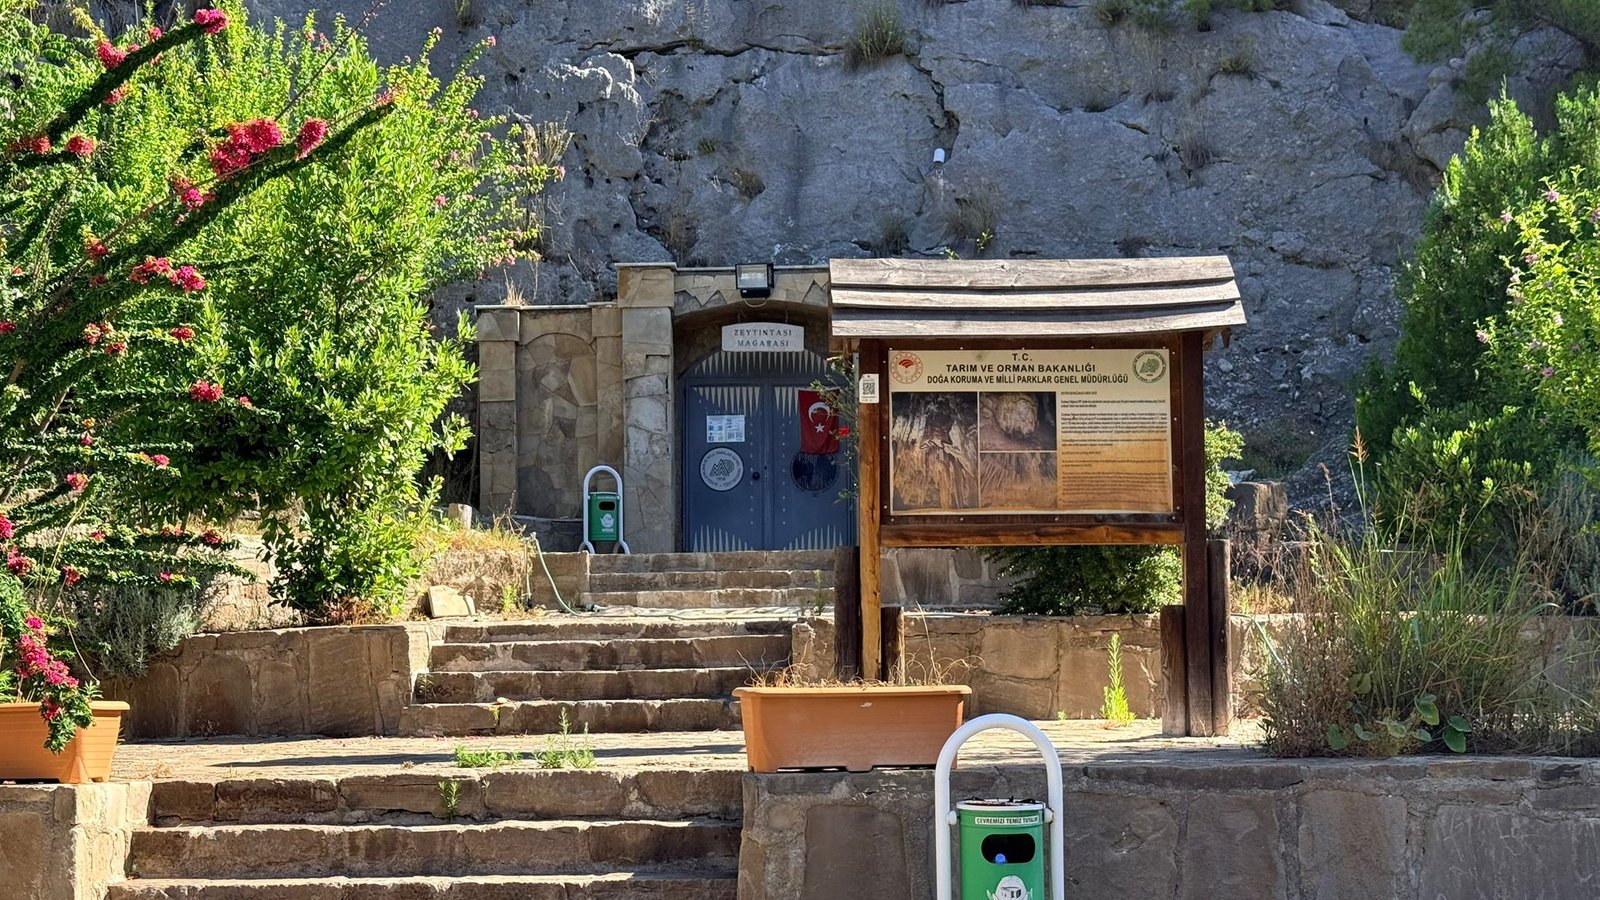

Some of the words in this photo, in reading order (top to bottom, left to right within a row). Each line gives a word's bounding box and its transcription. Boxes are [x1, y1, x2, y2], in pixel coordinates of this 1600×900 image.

[1011, 353, 1033, 361] T.C.
[946, 364, 978, 373] TARIM
[980, 364, 994, 373] VE
[996, 364, 1035, 373] ORMAN
[1038, 362, 1096, 373] BAKANLIĞI
[927, 374, 949, 384] DOĞA
[950, 375, 983, 384] KORUMA
[984, 375, 995, 384] VE
[996, 374, 1016, 384] MİLLİ
[1017, 375, 1052, 384] PARKLAR
[1053, 375, 1080, 384] GENEL
[1080, 373, 1129, 384] MÜDÜRLÜĞÜ
